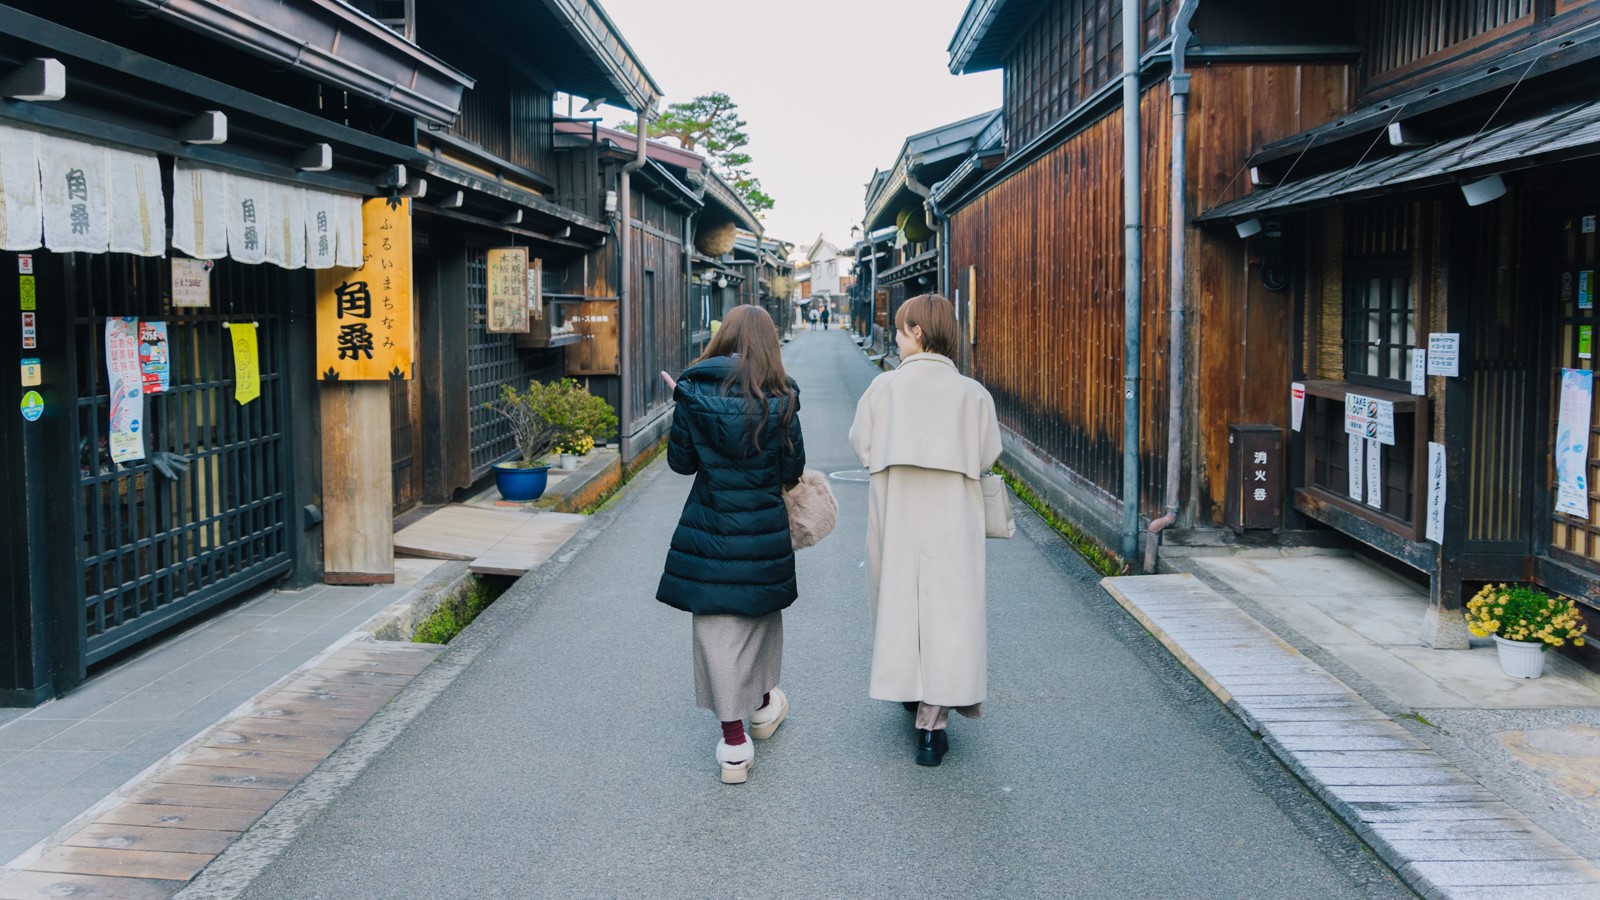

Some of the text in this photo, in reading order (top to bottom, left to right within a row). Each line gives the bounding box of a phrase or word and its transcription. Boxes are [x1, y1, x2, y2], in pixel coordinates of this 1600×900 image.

[65, 167, 90, 235] 角桑
[242, 198, 259, 251] 角桑
[316, 210, 329, 257] 角桑
[379, 218, 396, 350] ふるいまちなみ
[333, 280, 375, 361] 角桑
[1352, 396, 1367, 407] TAKE
[1352, 405, 1363, 415] OUT
[1253, 451, 1268, 501] 消火器
